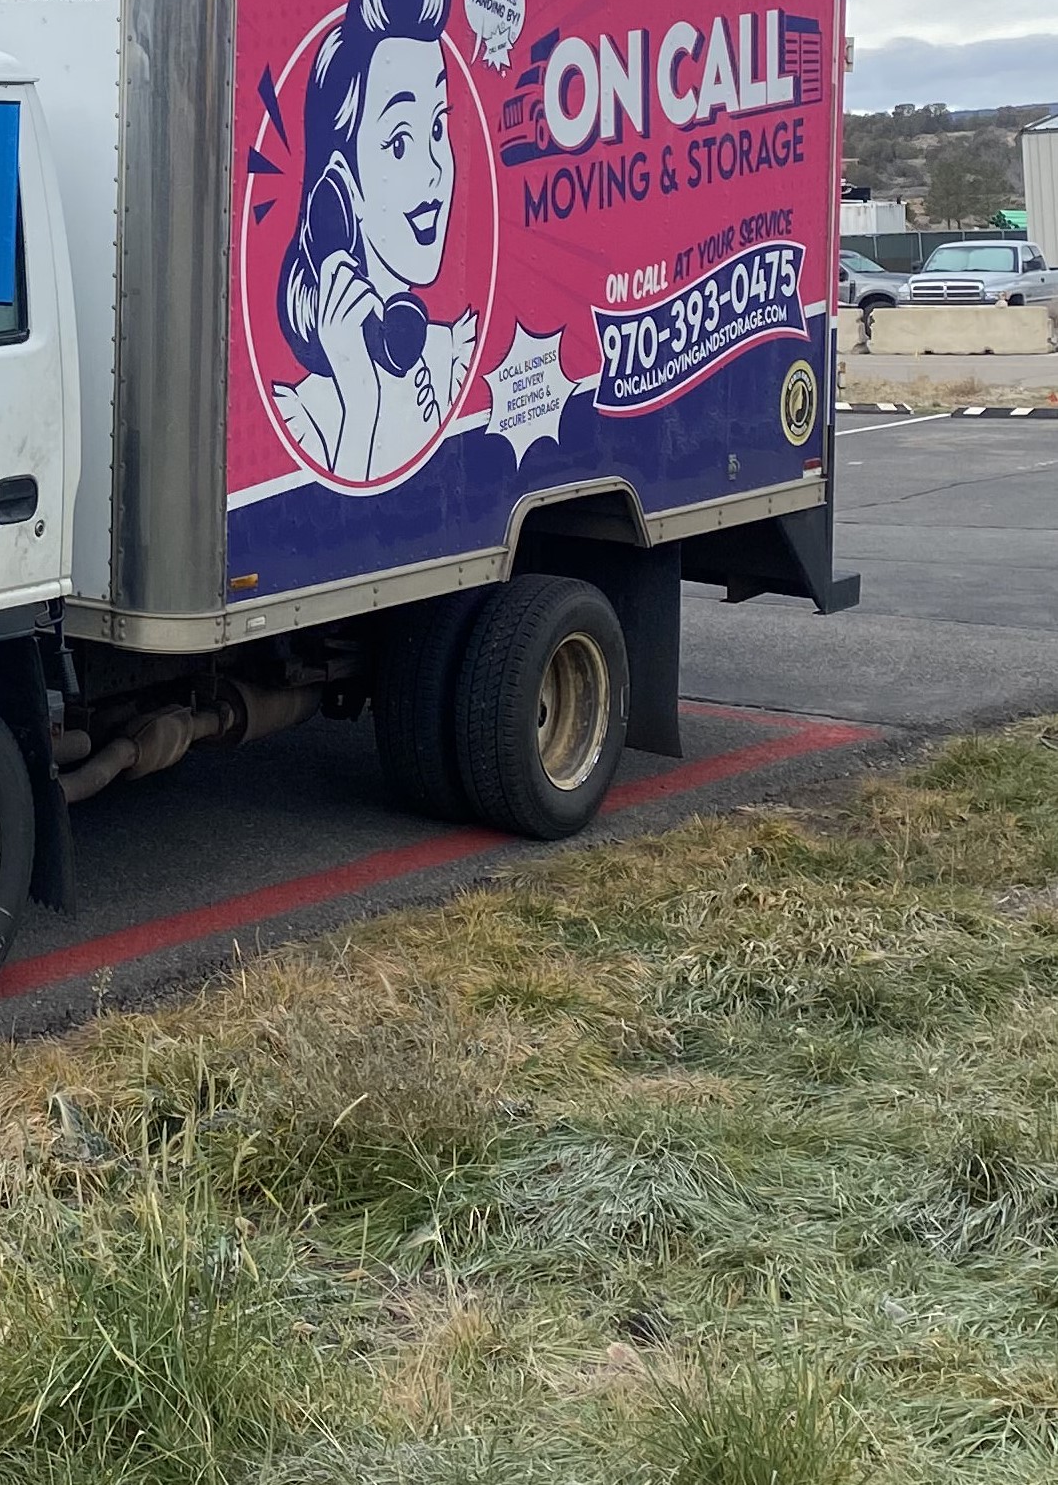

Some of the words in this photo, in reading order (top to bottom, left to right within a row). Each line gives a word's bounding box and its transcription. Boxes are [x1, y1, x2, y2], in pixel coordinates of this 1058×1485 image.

[506, 8, 521, 26] BY!
[544, 29, 646, 151] ON
[657, 9, 797, 128] CALL
[523, 151, 651, 228] MOVING
[660, 145, 679, 196] &
[687, 117, 805, 189] STORAGE
[606, 272, 629, 304] ON
[632, 260, 669, 300] CALL
[673, 247, 695, 284] AT
[697, 225, 735, 269] YOUR
[739, 208, 795, 247] SERVICE
[603, 249, 797, 378] 970-393-0475
[498, 362, 524, 383] LOCAL
[524, 350, 557, 374] BUSINESS
[512, 370, 545, 394] DELIVERY
[614, 304, 788, 399] ONCALLMOVINGANDSTORAGE.COM
[499, 413, 527, 432] SECURE
[527, 398, 560, 421] STORAGE
[507, 387, 545, 412] RECEIVING
[546, 385, 552, 397] &
